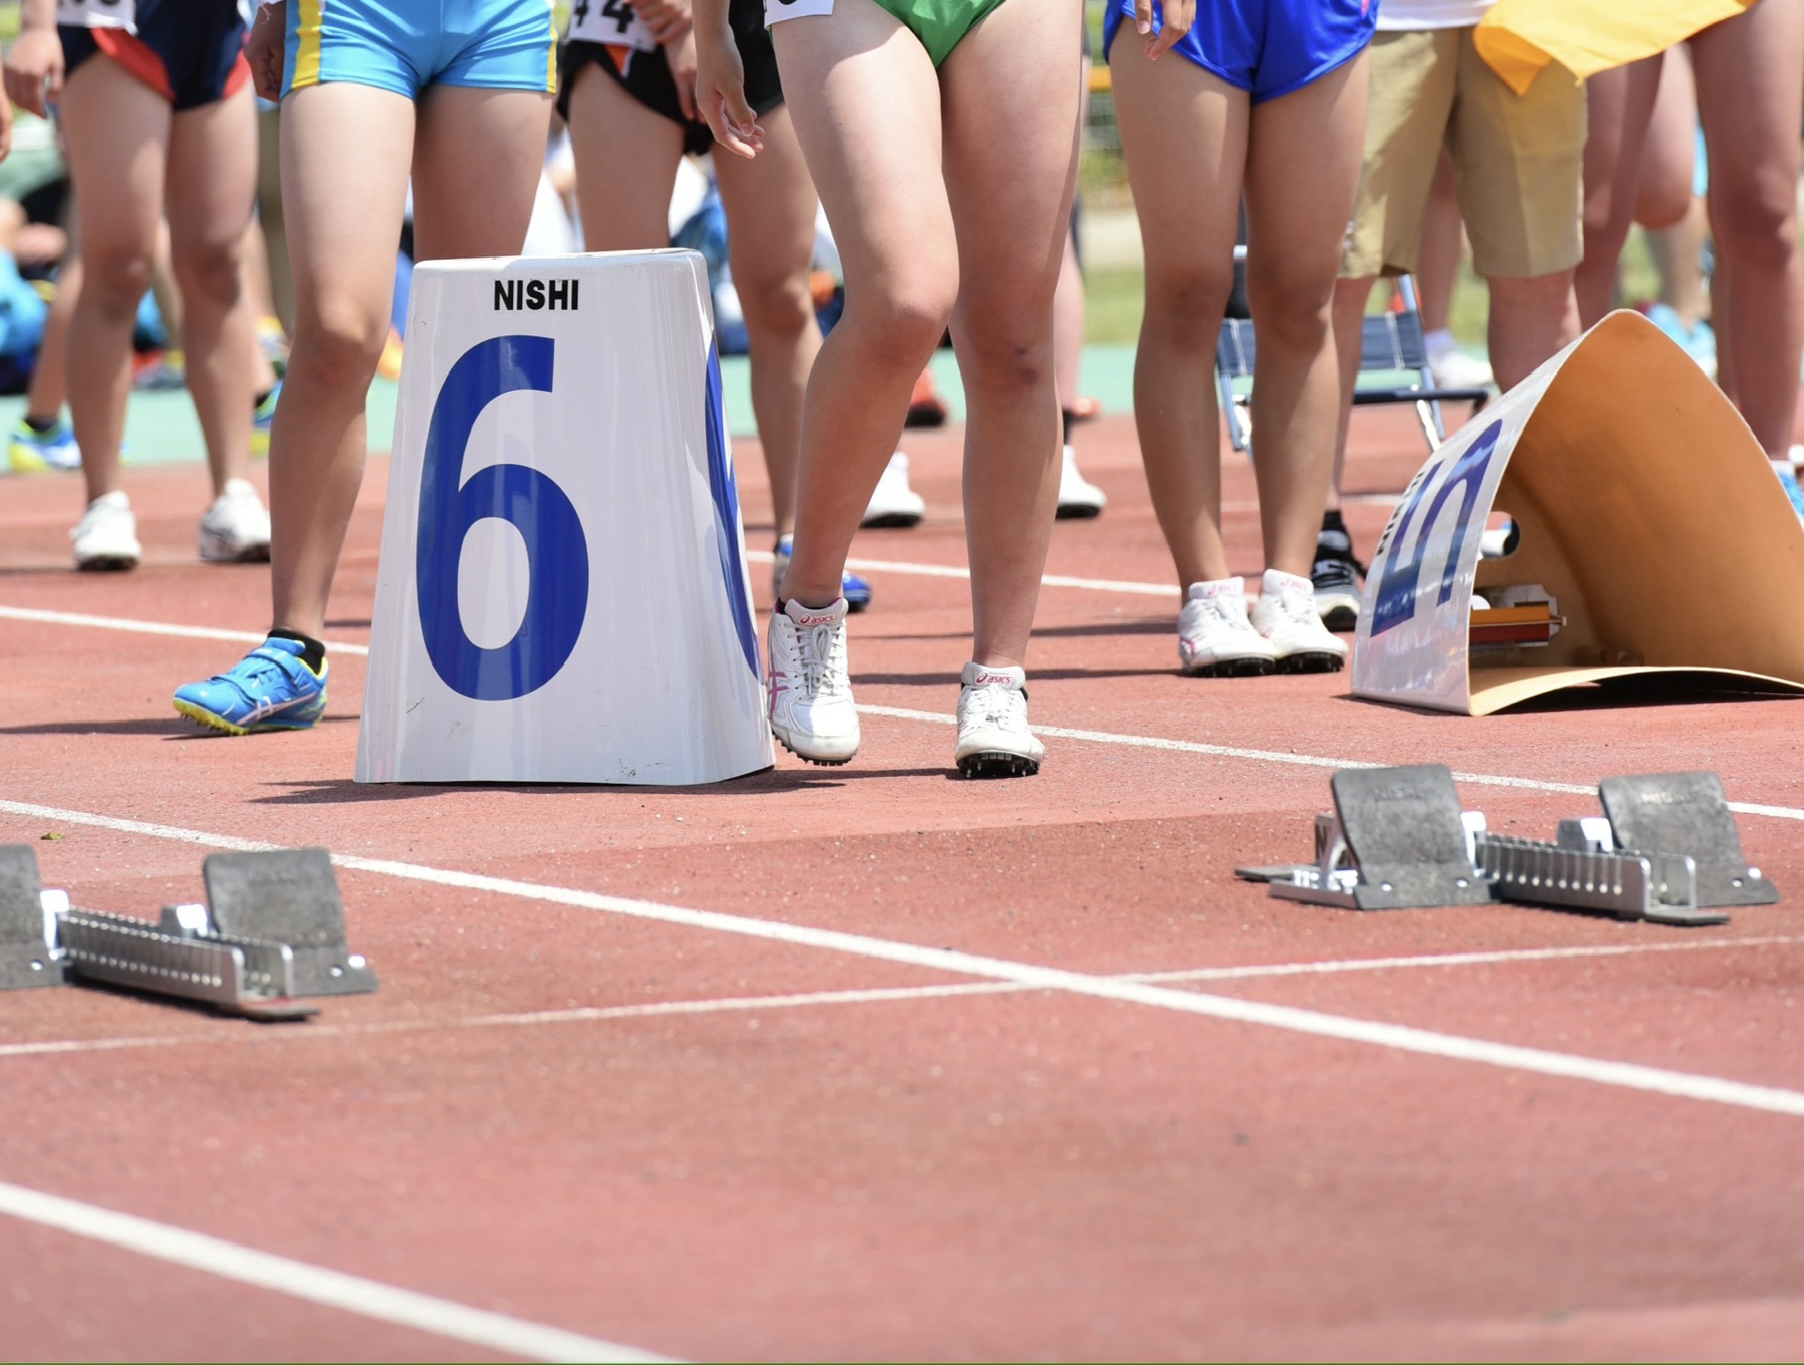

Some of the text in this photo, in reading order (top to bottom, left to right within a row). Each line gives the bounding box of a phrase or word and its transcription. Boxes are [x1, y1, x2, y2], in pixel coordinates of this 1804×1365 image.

[494, 279, 579, 311] NISHI
[416, 334, 589, 701] 6
[1370, 418, 1503, 639] 5
